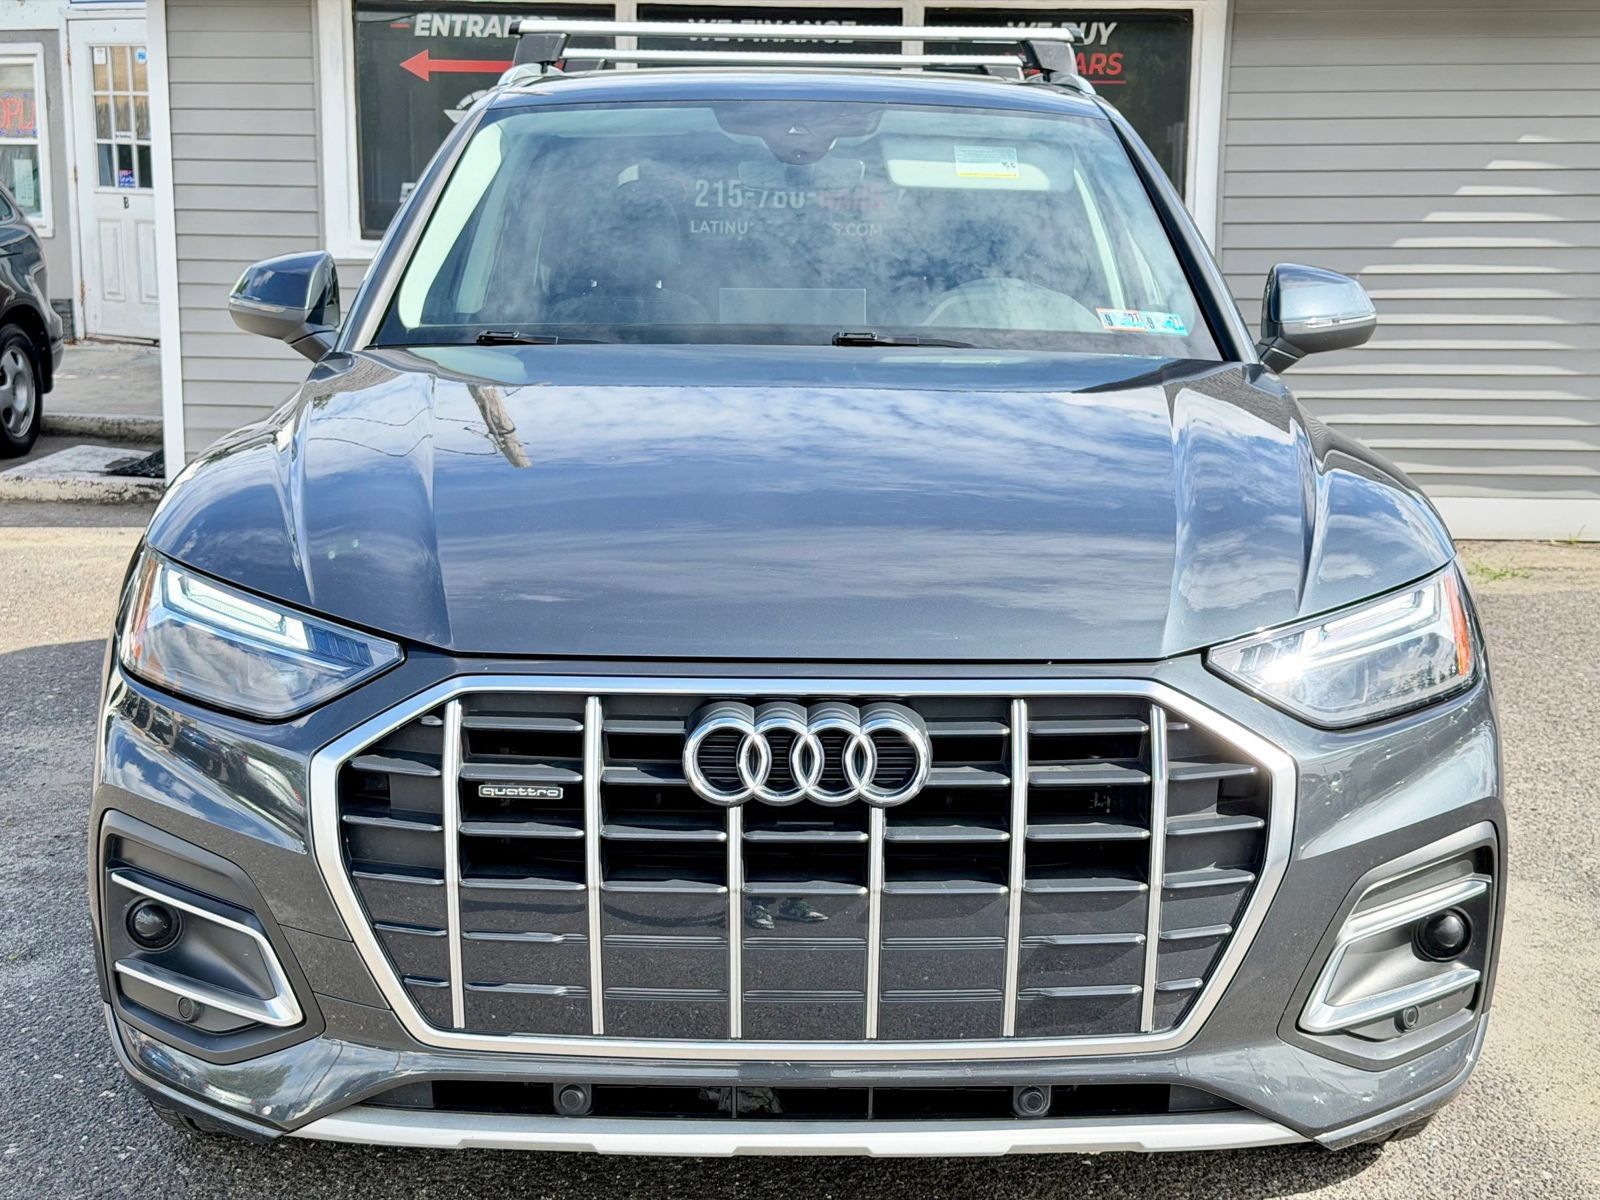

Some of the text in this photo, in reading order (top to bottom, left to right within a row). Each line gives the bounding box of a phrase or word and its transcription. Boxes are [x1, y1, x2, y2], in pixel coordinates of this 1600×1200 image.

[414, 13, 559, 38] ENTRAN
[1061, 22, 1117, 46] UY
[1076, 52, 1124, 76] ARS
[482, 788, 559, 797] quattro
